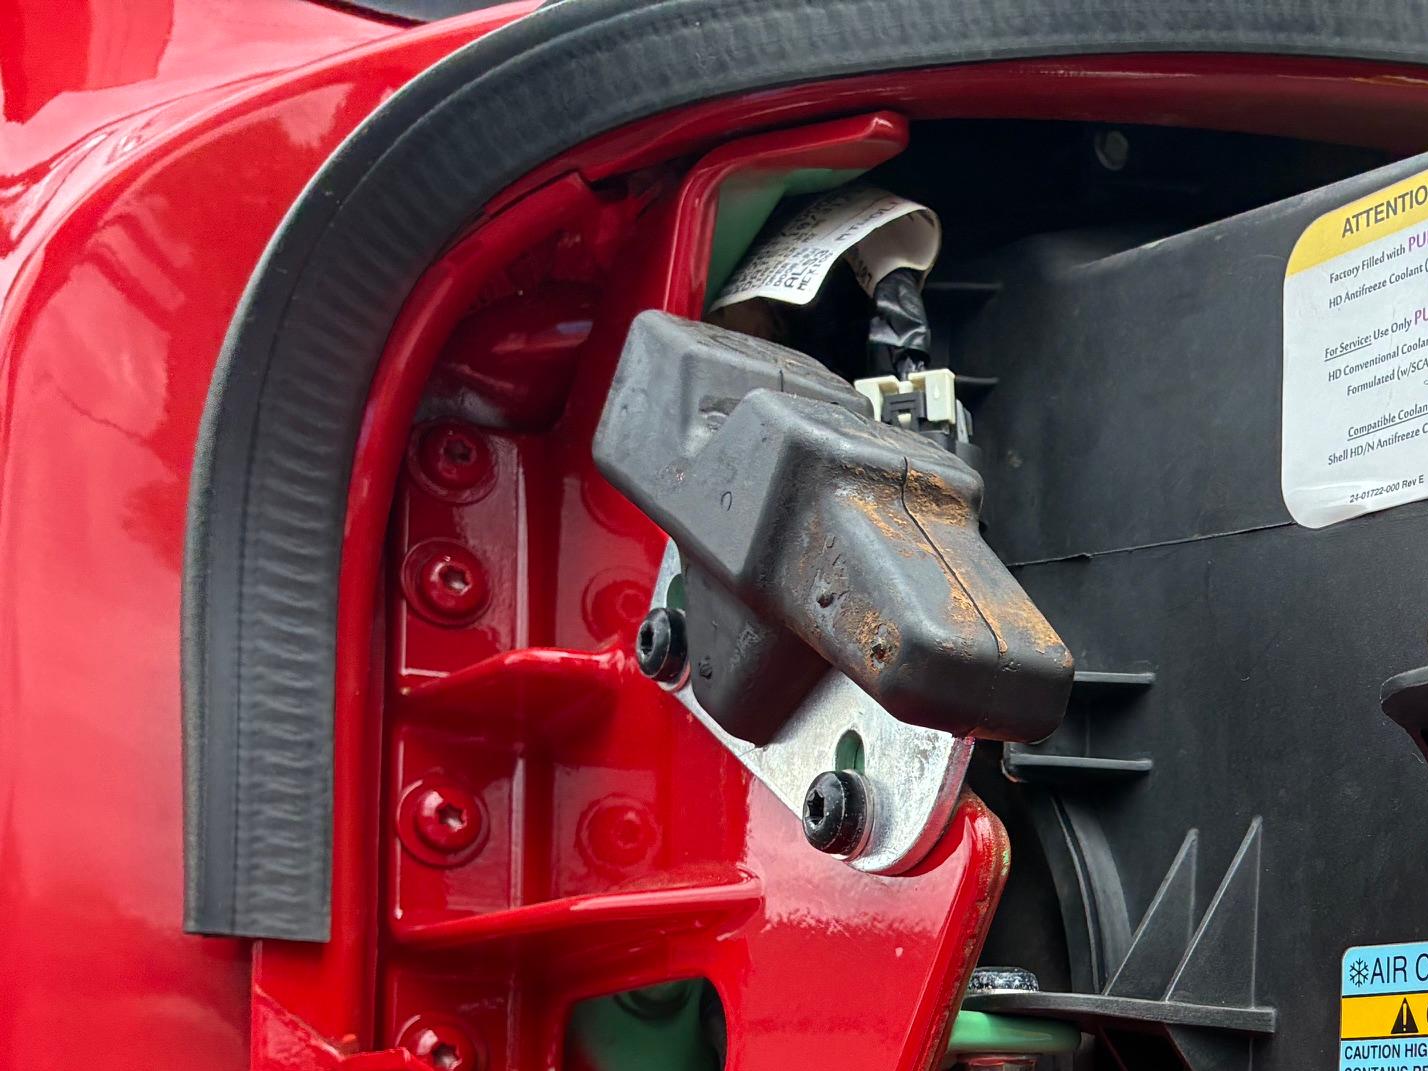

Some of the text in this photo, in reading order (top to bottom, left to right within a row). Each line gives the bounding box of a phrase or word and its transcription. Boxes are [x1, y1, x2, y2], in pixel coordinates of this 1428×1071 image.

[1329, 265, 1360, 284] Factory
[1361, 252, 1385, 271] Filled
[1386, 244, 1406, 263] with
[1329, 294, 1342, 309] HD
[1344, 278, 1387, 302] Antifreeze
[1389, 264, 1423, 284] Coolant
[1324, 345, 1338, 359] For
[1339, 334, 1372, 356] Service:
[1373, 324, 1389, 341] Use
[1391, 317, 1412, 334] Only
[1328, 368, 1342, 382] HD
[1343, 346, 1399, 376] Conventional
[1347, 370, 1395, 396] Formulated
[1348, 412, 1396, 438] Compatible
[1328, 449, 1348, 466] Shell
[1350, 440, 1374, 459] HD/N
[1377, 427, 1420, 450] Antifreeze
[1350, 475, 1424, 503] 24-01722-000 Rev E
[1371, 955, 1407, 984] AIR
[1345, 1043, 1400, 1059] CAUTION
